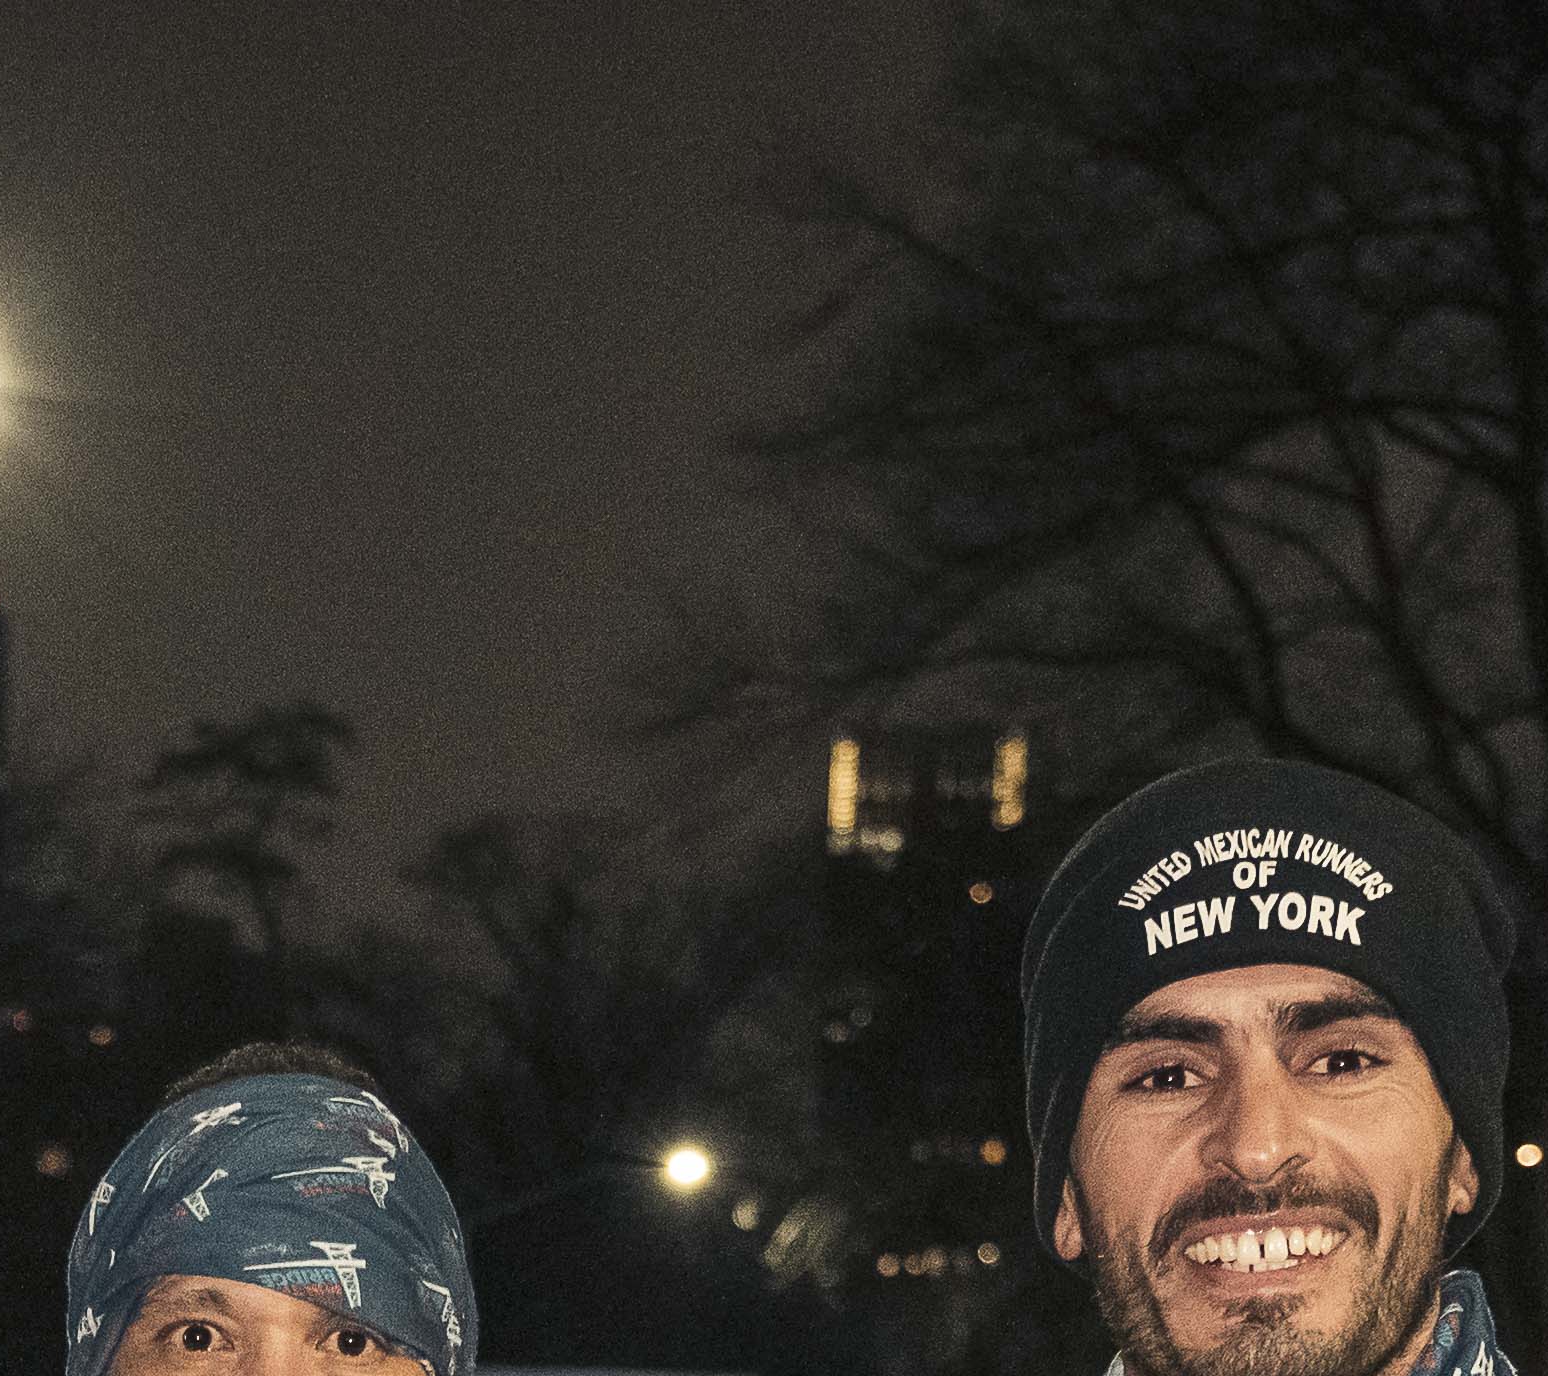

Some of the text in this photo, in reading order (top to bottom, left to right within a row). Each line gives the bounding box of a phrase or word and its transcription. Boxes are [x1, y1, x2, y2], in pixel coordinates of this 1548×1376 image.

[1118, 828, 1393, 911] UNITED MEXICAN RUNNERS
[1232, 861, 1277, 889] OF
[1144, 892, 1366, 955] NEW YORK
